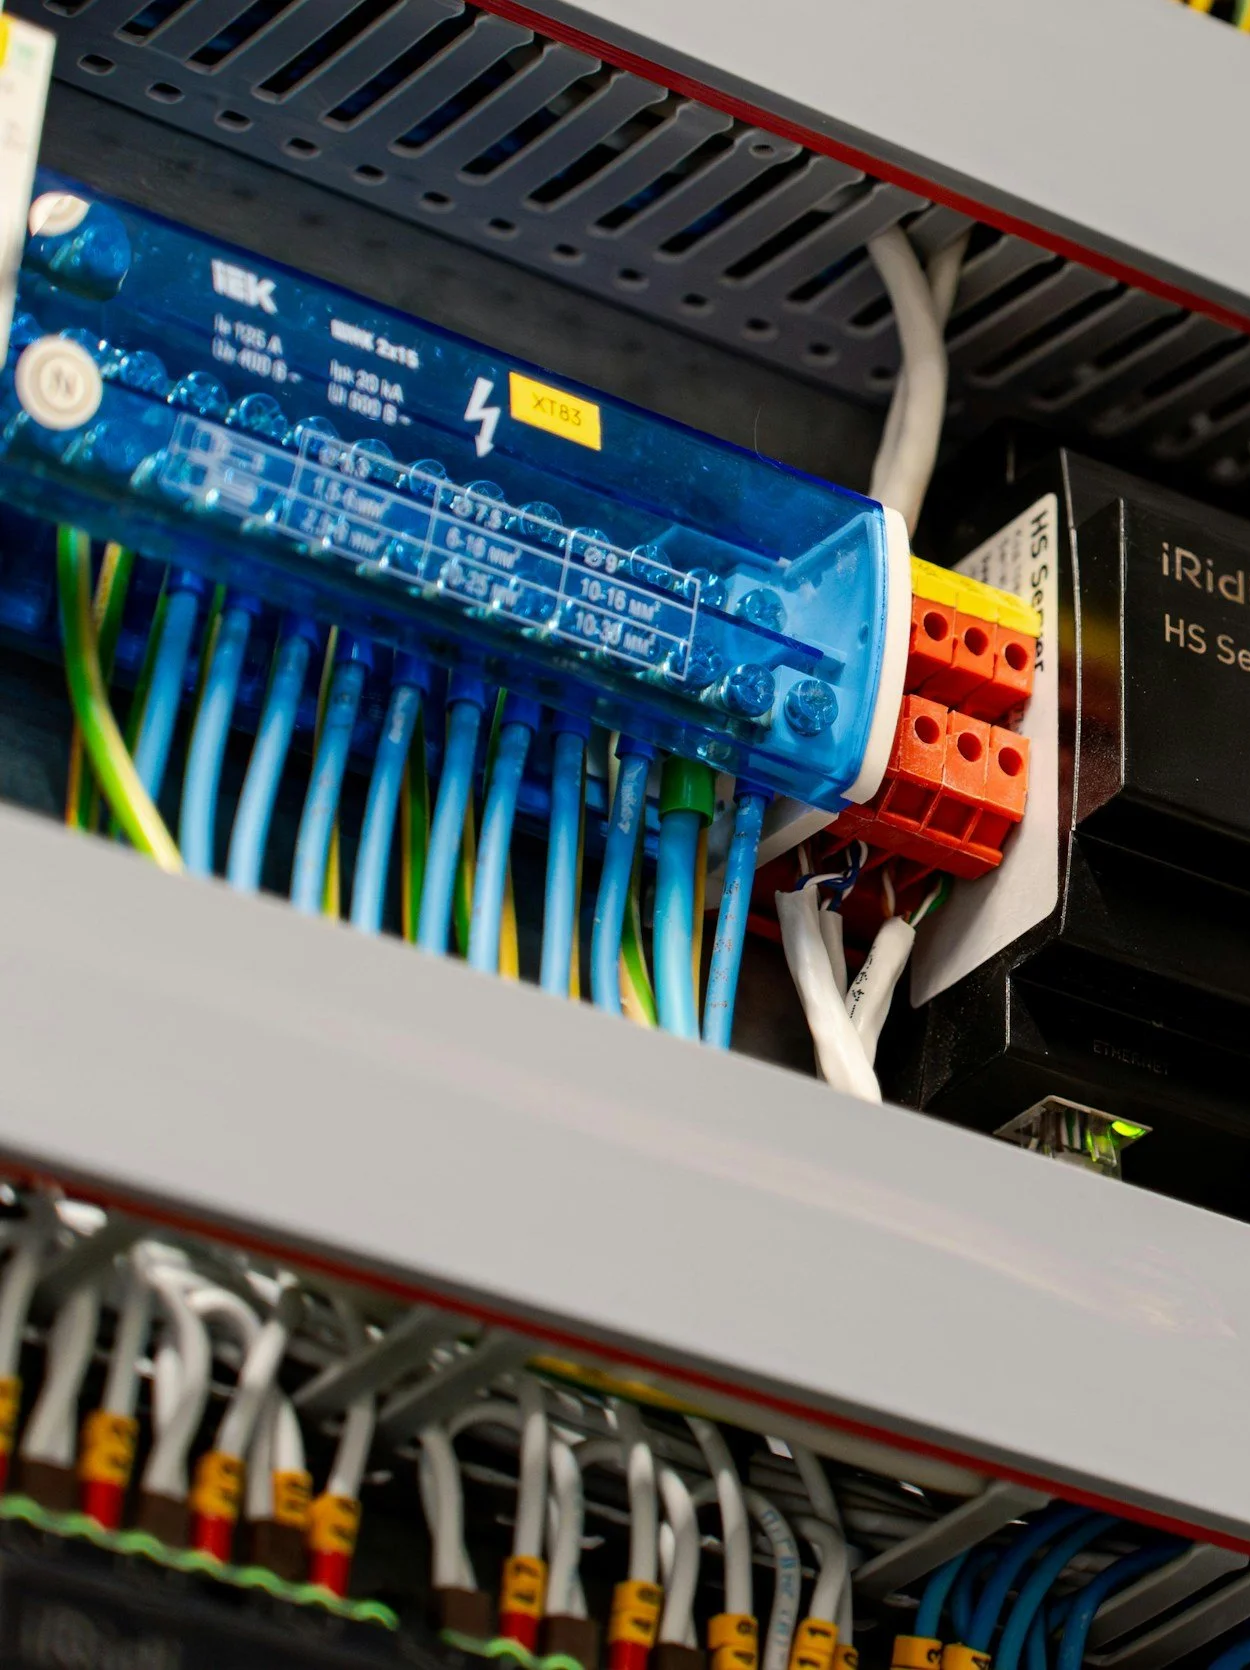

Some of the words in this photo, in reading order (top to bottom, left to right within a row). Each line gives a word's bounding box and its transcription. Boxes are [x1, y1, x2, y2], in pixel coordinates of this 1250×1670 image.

[211, 258, 278, 315] IEK
[532, 391, 582, 427] XT83
[1031, 509, 1050, 560] HS
[1164, 613, 1207, 655] HS
